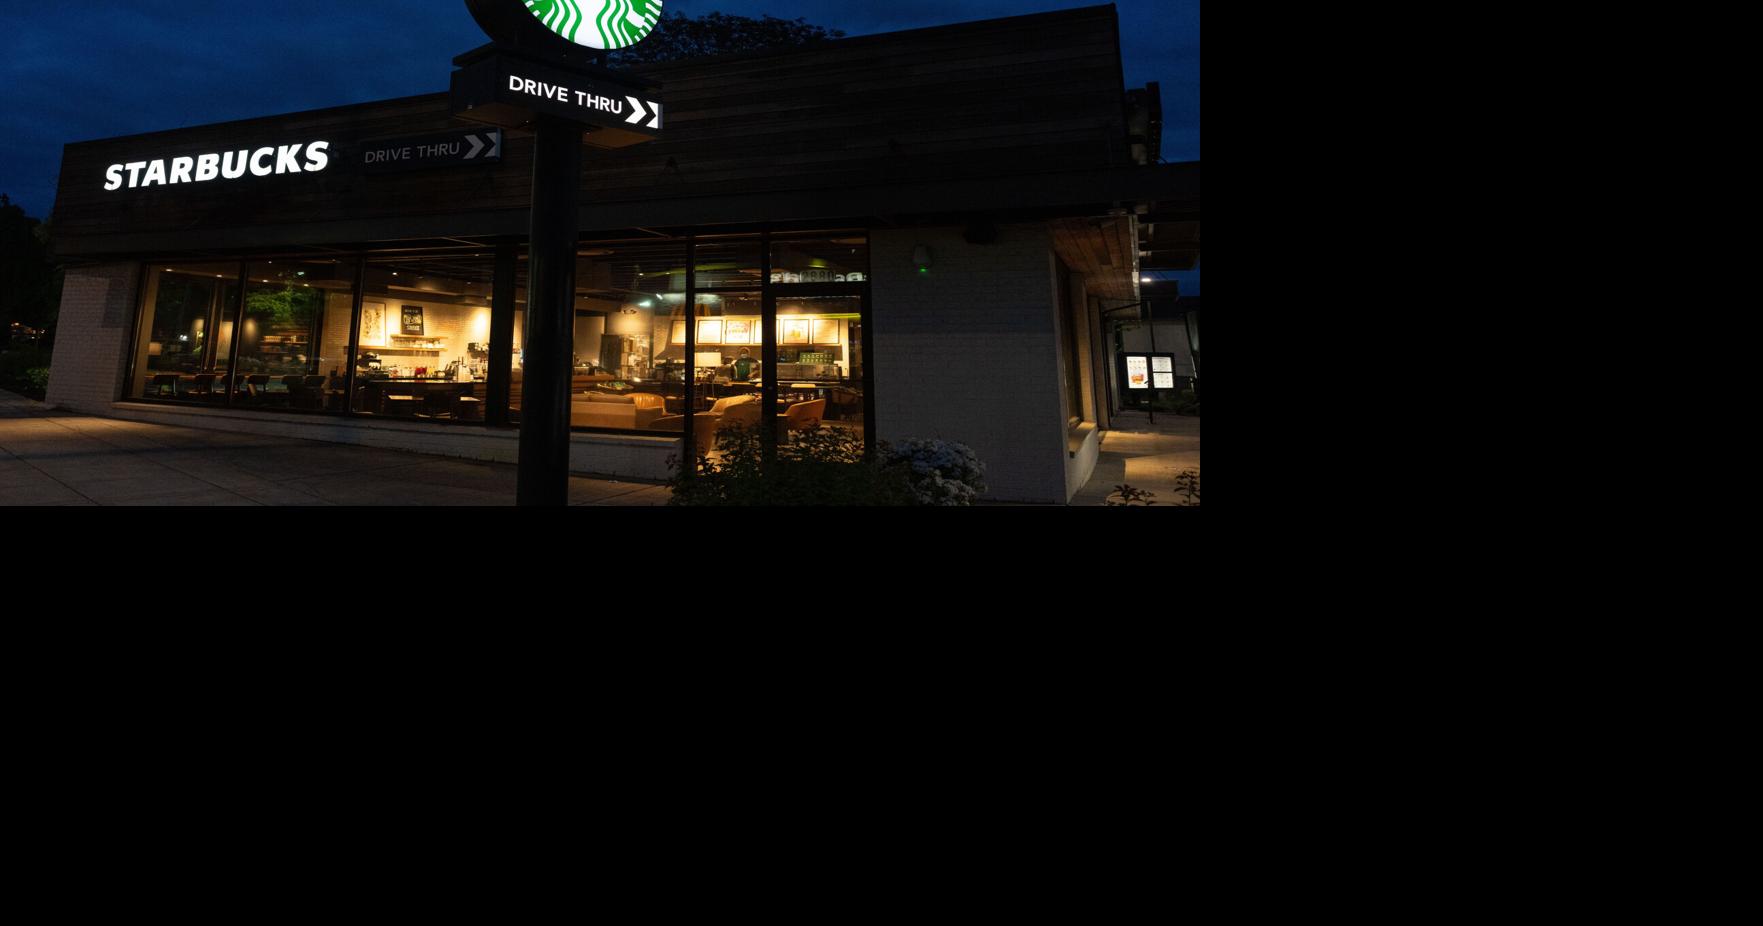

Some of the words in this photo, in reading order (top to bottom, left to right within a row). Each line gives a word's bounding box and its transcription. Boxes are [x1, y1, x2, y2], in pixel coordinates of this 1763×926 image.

[508, 75, 568, 103] DRIVE
[574, 89, 623, 115] THRU
[103, 140, 330, 191] STARBUCKS
[363, 146, 409, 164] DRIVE
[415, 142, 461, 159] THRU
